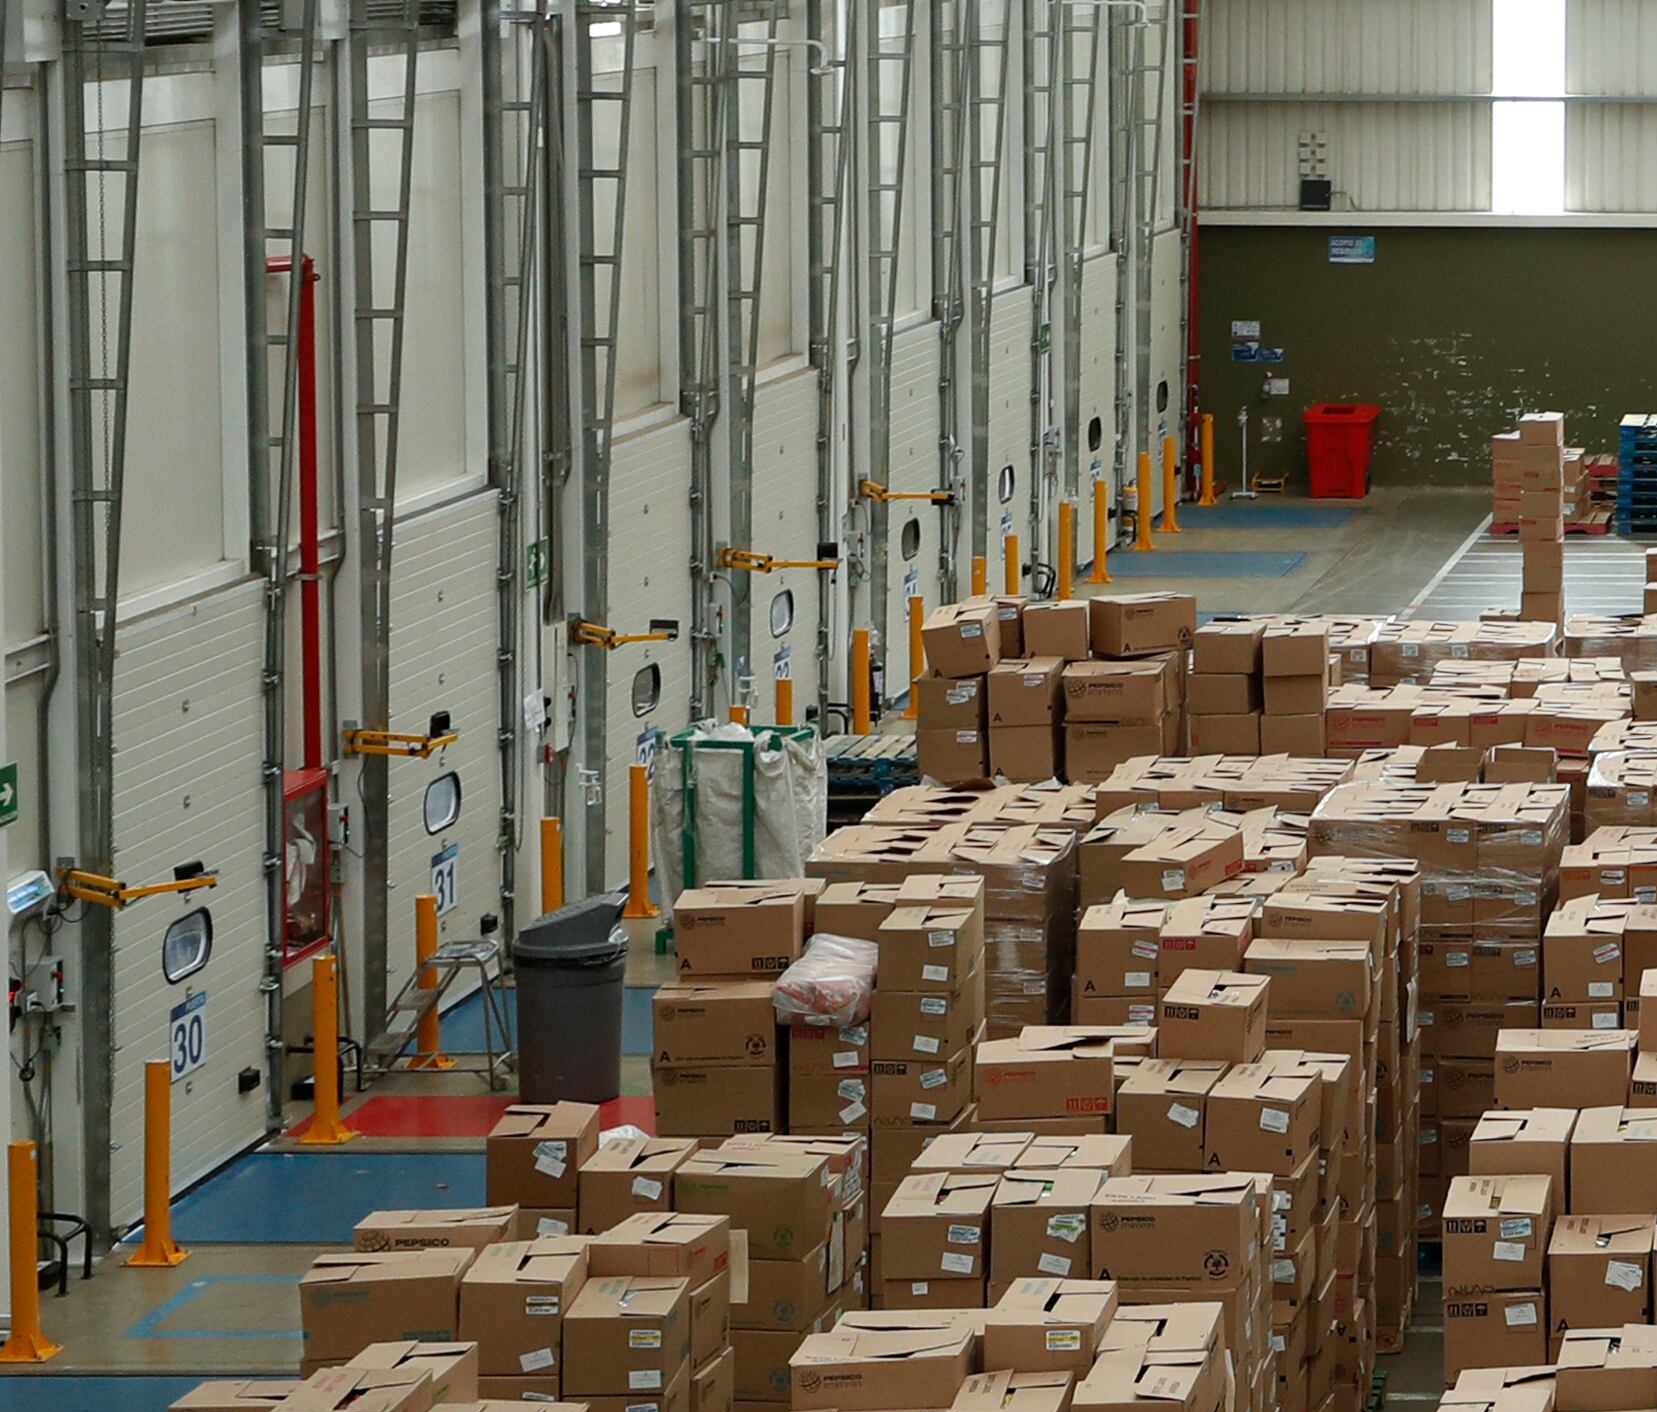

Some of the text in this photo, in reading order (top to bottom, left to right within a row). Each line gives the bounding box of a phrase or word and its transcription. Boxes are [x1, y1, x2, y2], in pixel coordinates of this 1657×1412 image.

[435, 863, 455, 912] 31
[681, 958, 691, 969] A
[1085, 979, 1095, 991] A
[1551, 987, 1561, 998] A
[174, 1015, 203, 1074] 30
[659, 1051, 669, 1062] A
[1209, 1154, 1220, 1165] A
[394, 1238, 449, 1247] PEPSICO
